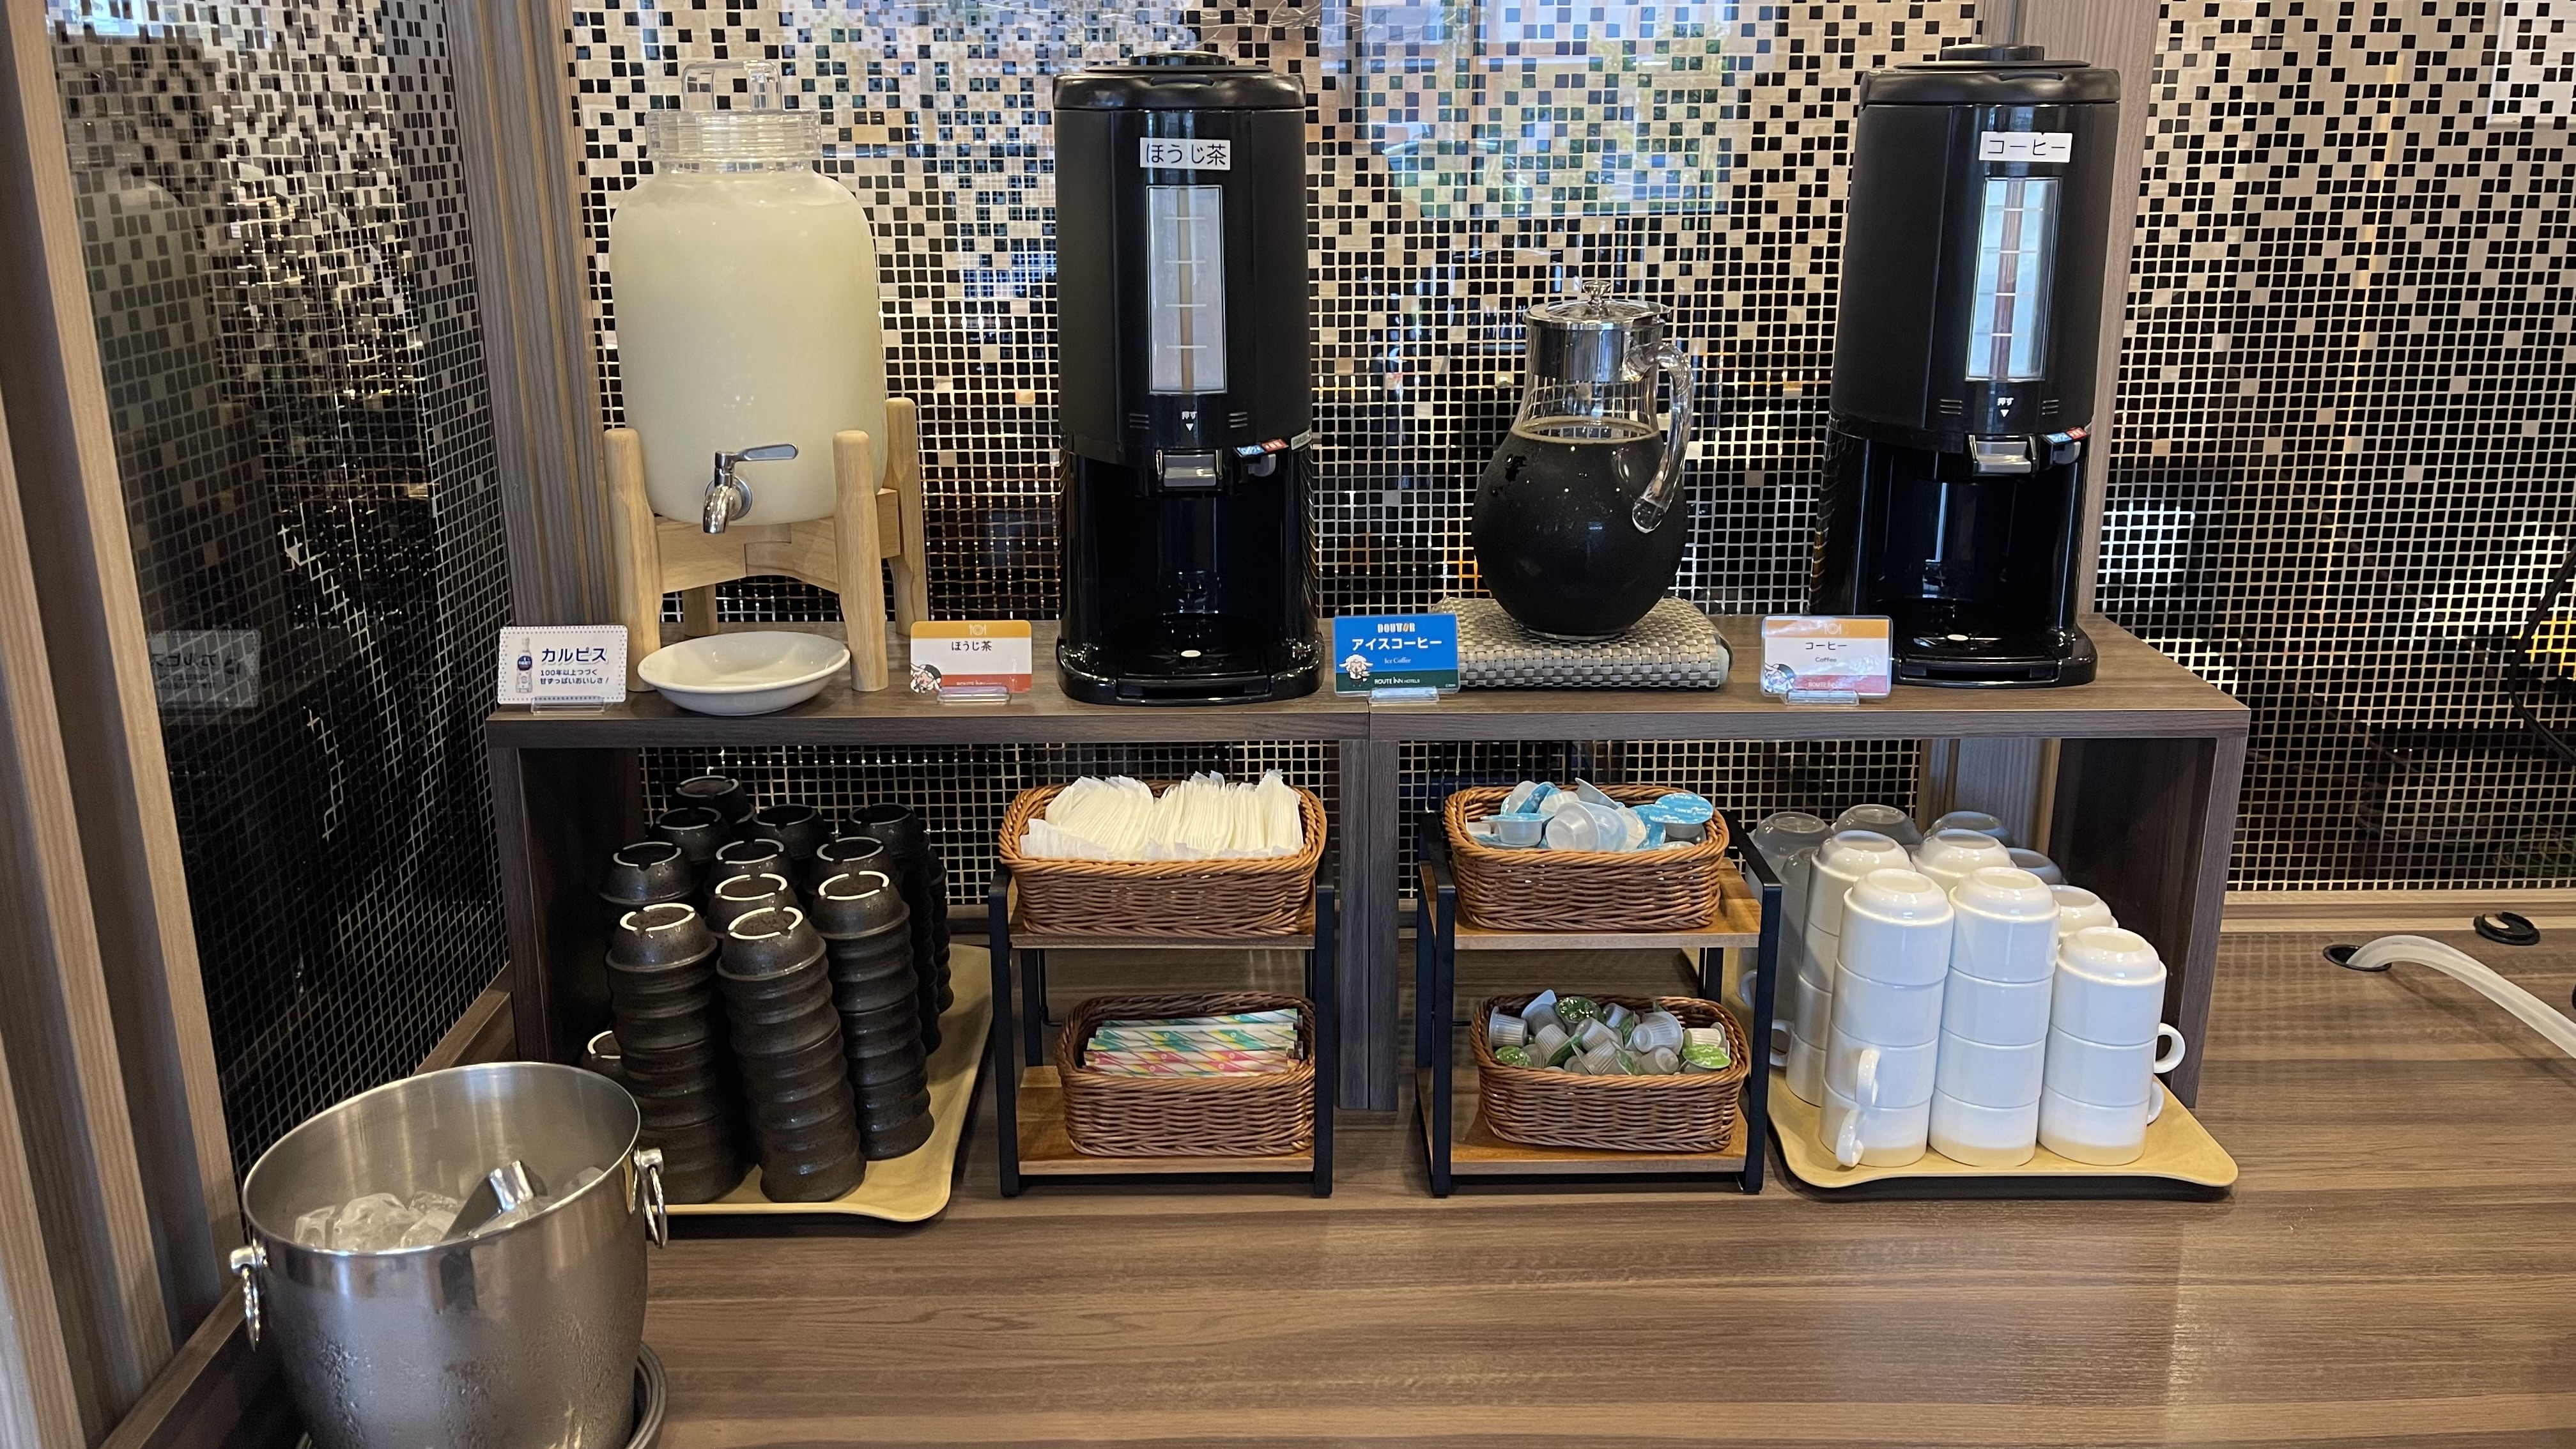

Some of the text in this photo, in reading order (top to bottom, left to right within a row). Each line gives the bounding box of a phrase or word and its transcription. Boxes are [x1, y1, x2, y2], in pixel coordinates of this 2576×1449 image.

[1146, 143, 1226, 166] ほうじ茶
[1987, 139, 2066, 156] コーヒー
[1377, 623, 1415, 633] DOUTOR
[951, 640, 992, 652] ほうじ茶
[1352, 637, 1442, 651] アイスコーヒー
[1805, 641, 1847, 651] コーヒー
[541, 647, 607, 663] カルピス
